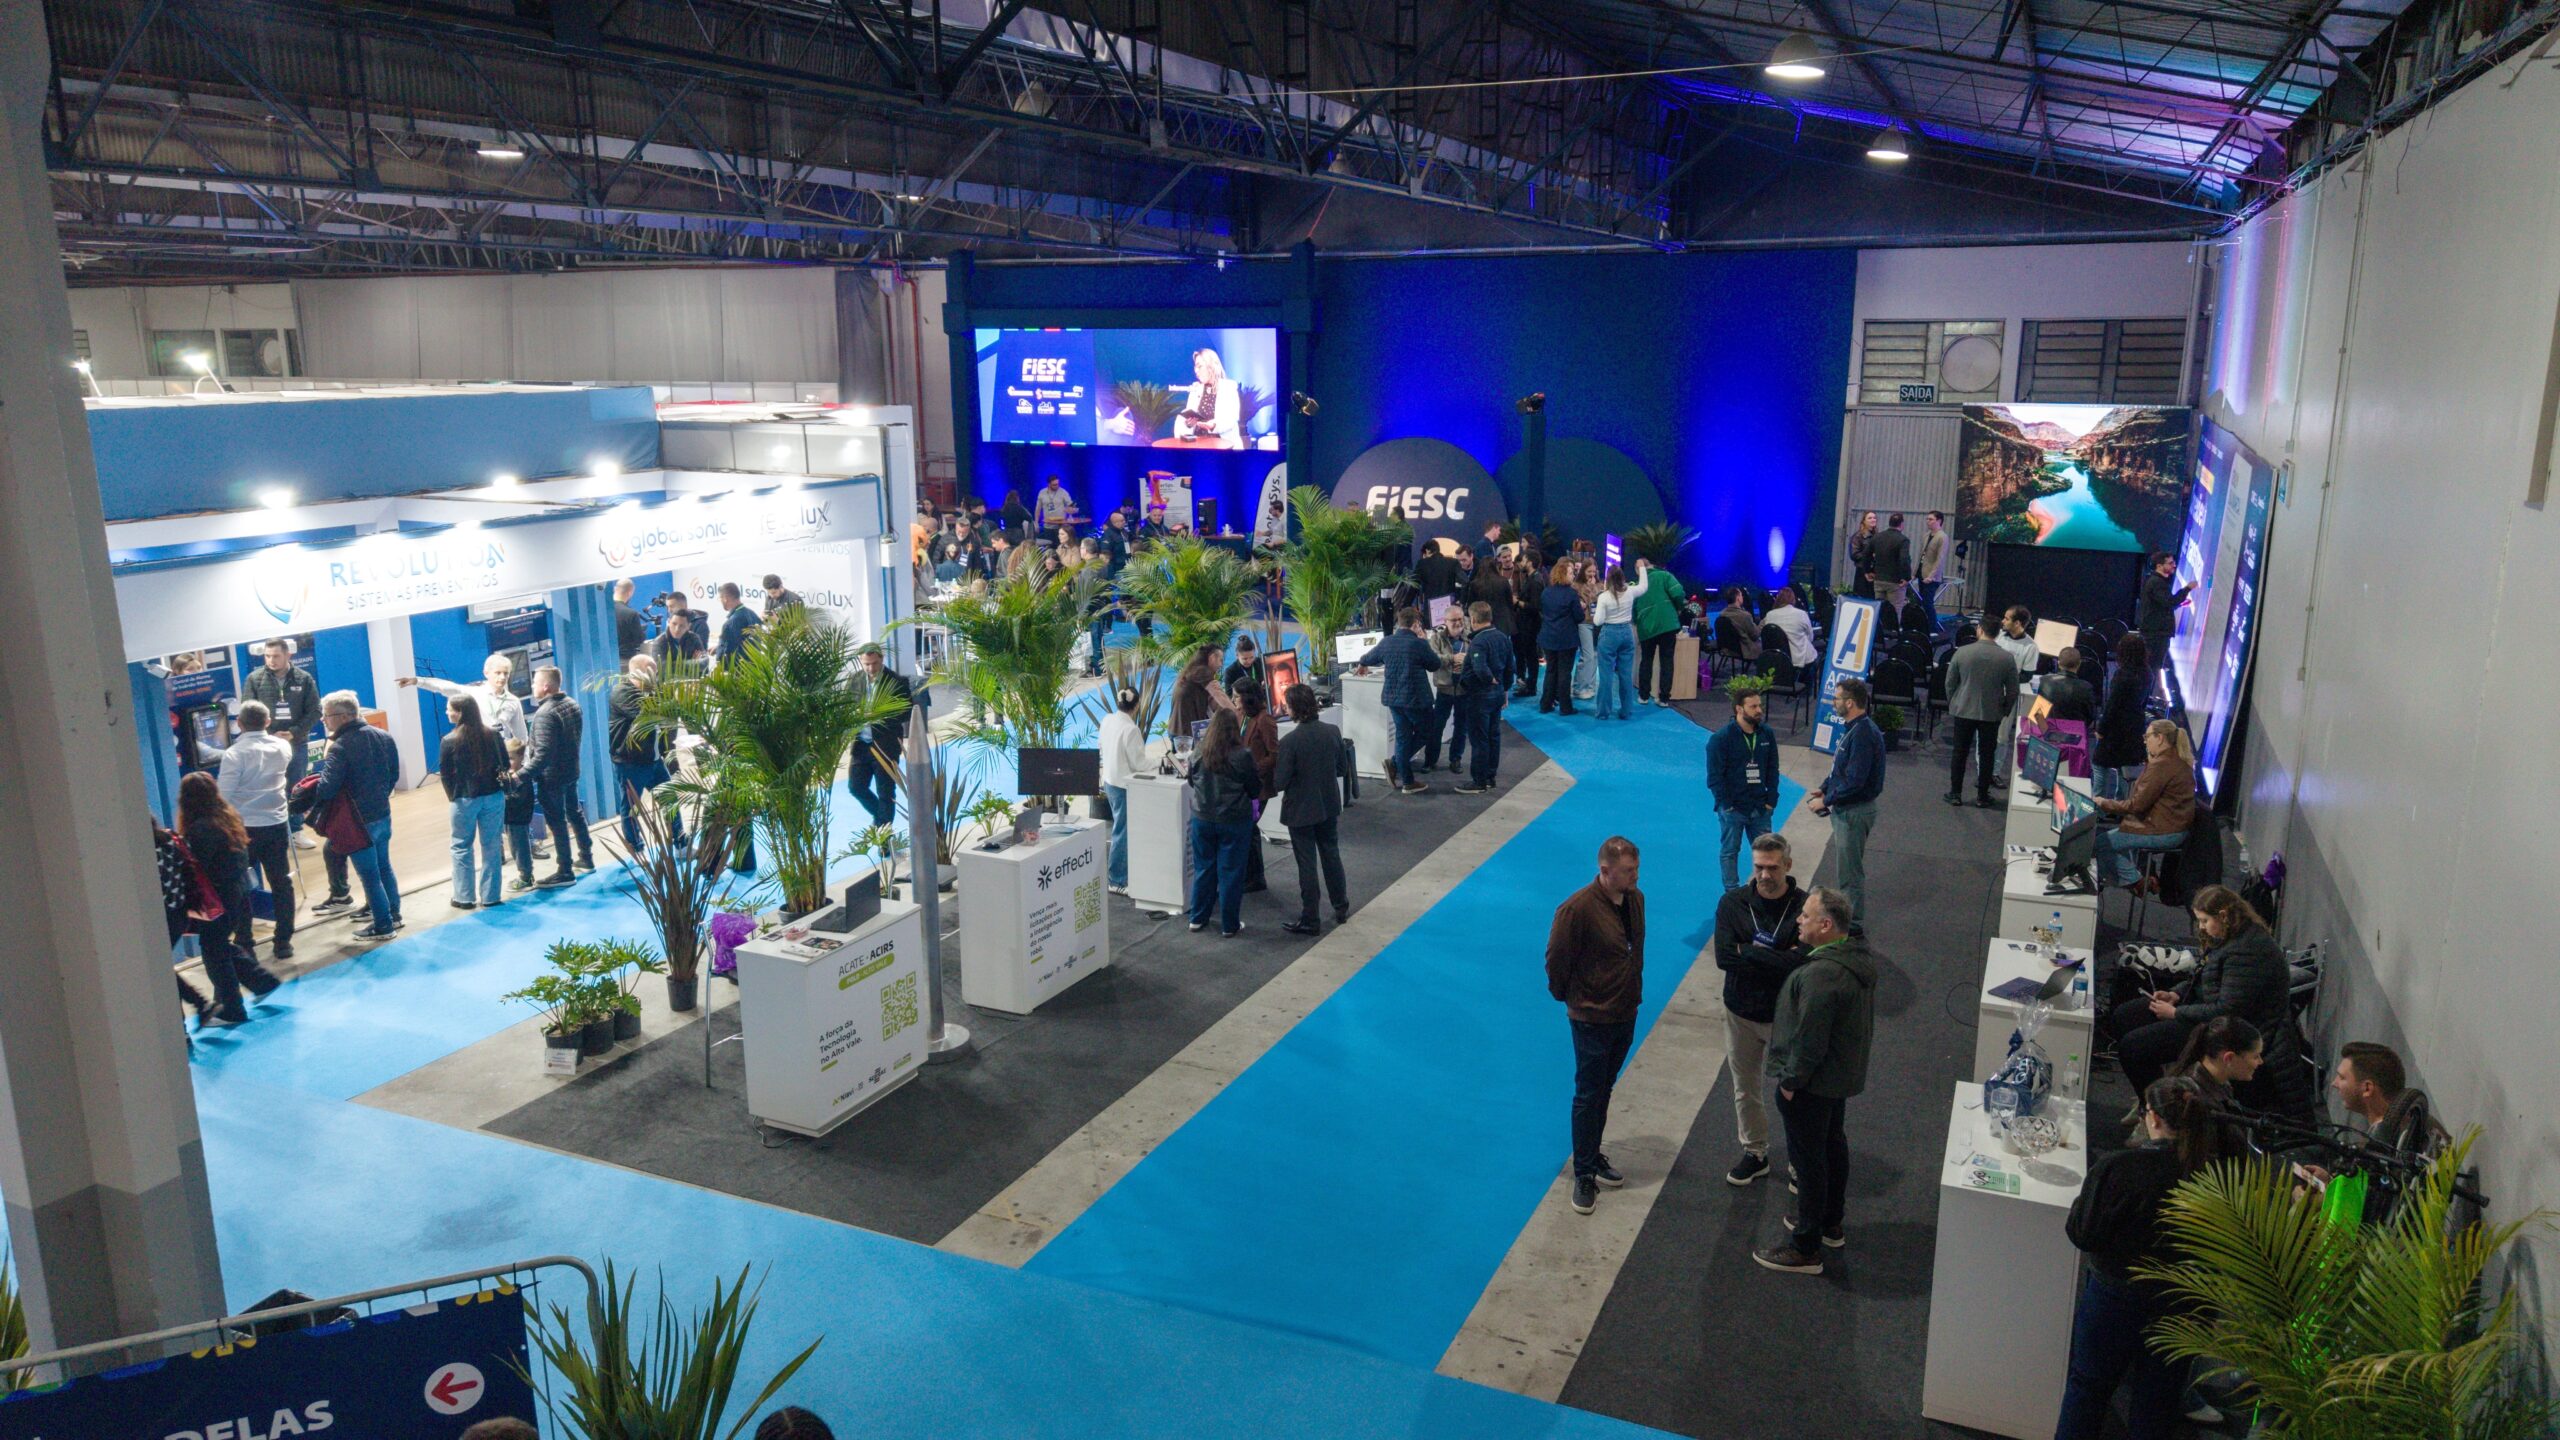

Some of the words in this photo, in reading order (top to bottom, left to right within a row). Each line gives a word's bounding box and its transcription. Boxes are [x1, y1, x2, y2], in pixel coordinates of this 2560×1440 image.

[329, 543, 505, 587] REOLUON
[1055, 846, 1093, 879] effecti
[839, 955, 865, 976] ACATE
[869, 940, 894, 960] ACIRS
[819, 1035, 825, 1043] A
[825, 1024, 844, 1040] força
[844, 1019, 853, 1029] da
[819, 1028, 857, 1054] Tecnologia
[820, 1056, 830, 1065] no
[830, 1046, 845, 1060] Alto
[846, 1037, 863, 1051] Vale.
